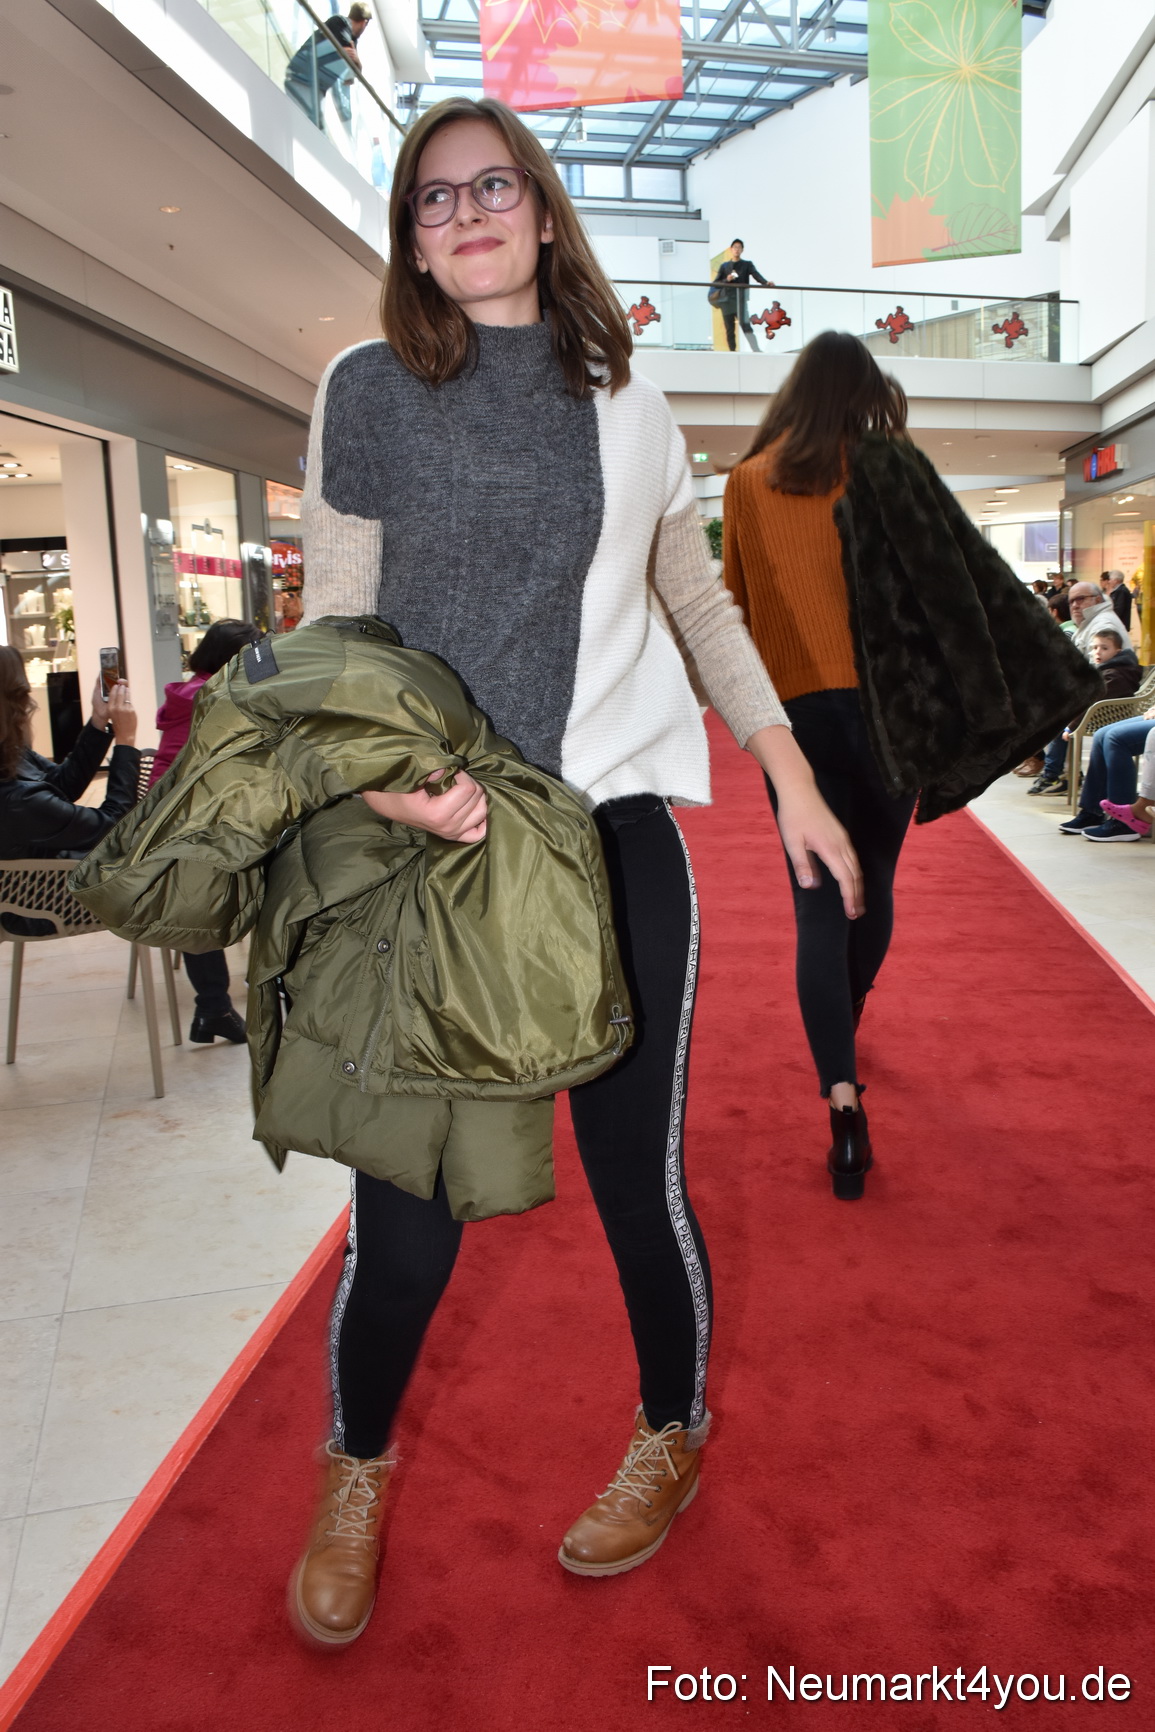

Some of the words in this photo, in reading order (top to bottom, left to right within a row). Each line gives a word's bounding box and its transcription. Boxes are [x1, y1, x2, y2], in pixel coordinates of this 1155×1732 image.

[271, 550, 302, 568] rvis
[678, 1008, 691, 1058] BERLIN
[669, 1063, 684, 1144] BARCELONA
[668, 1150, 684, 1222] STOCKHOLM
[678, 1225, 695, 1258] PARIS
[688, 1262, 708, 1324] AMSTERDAM
